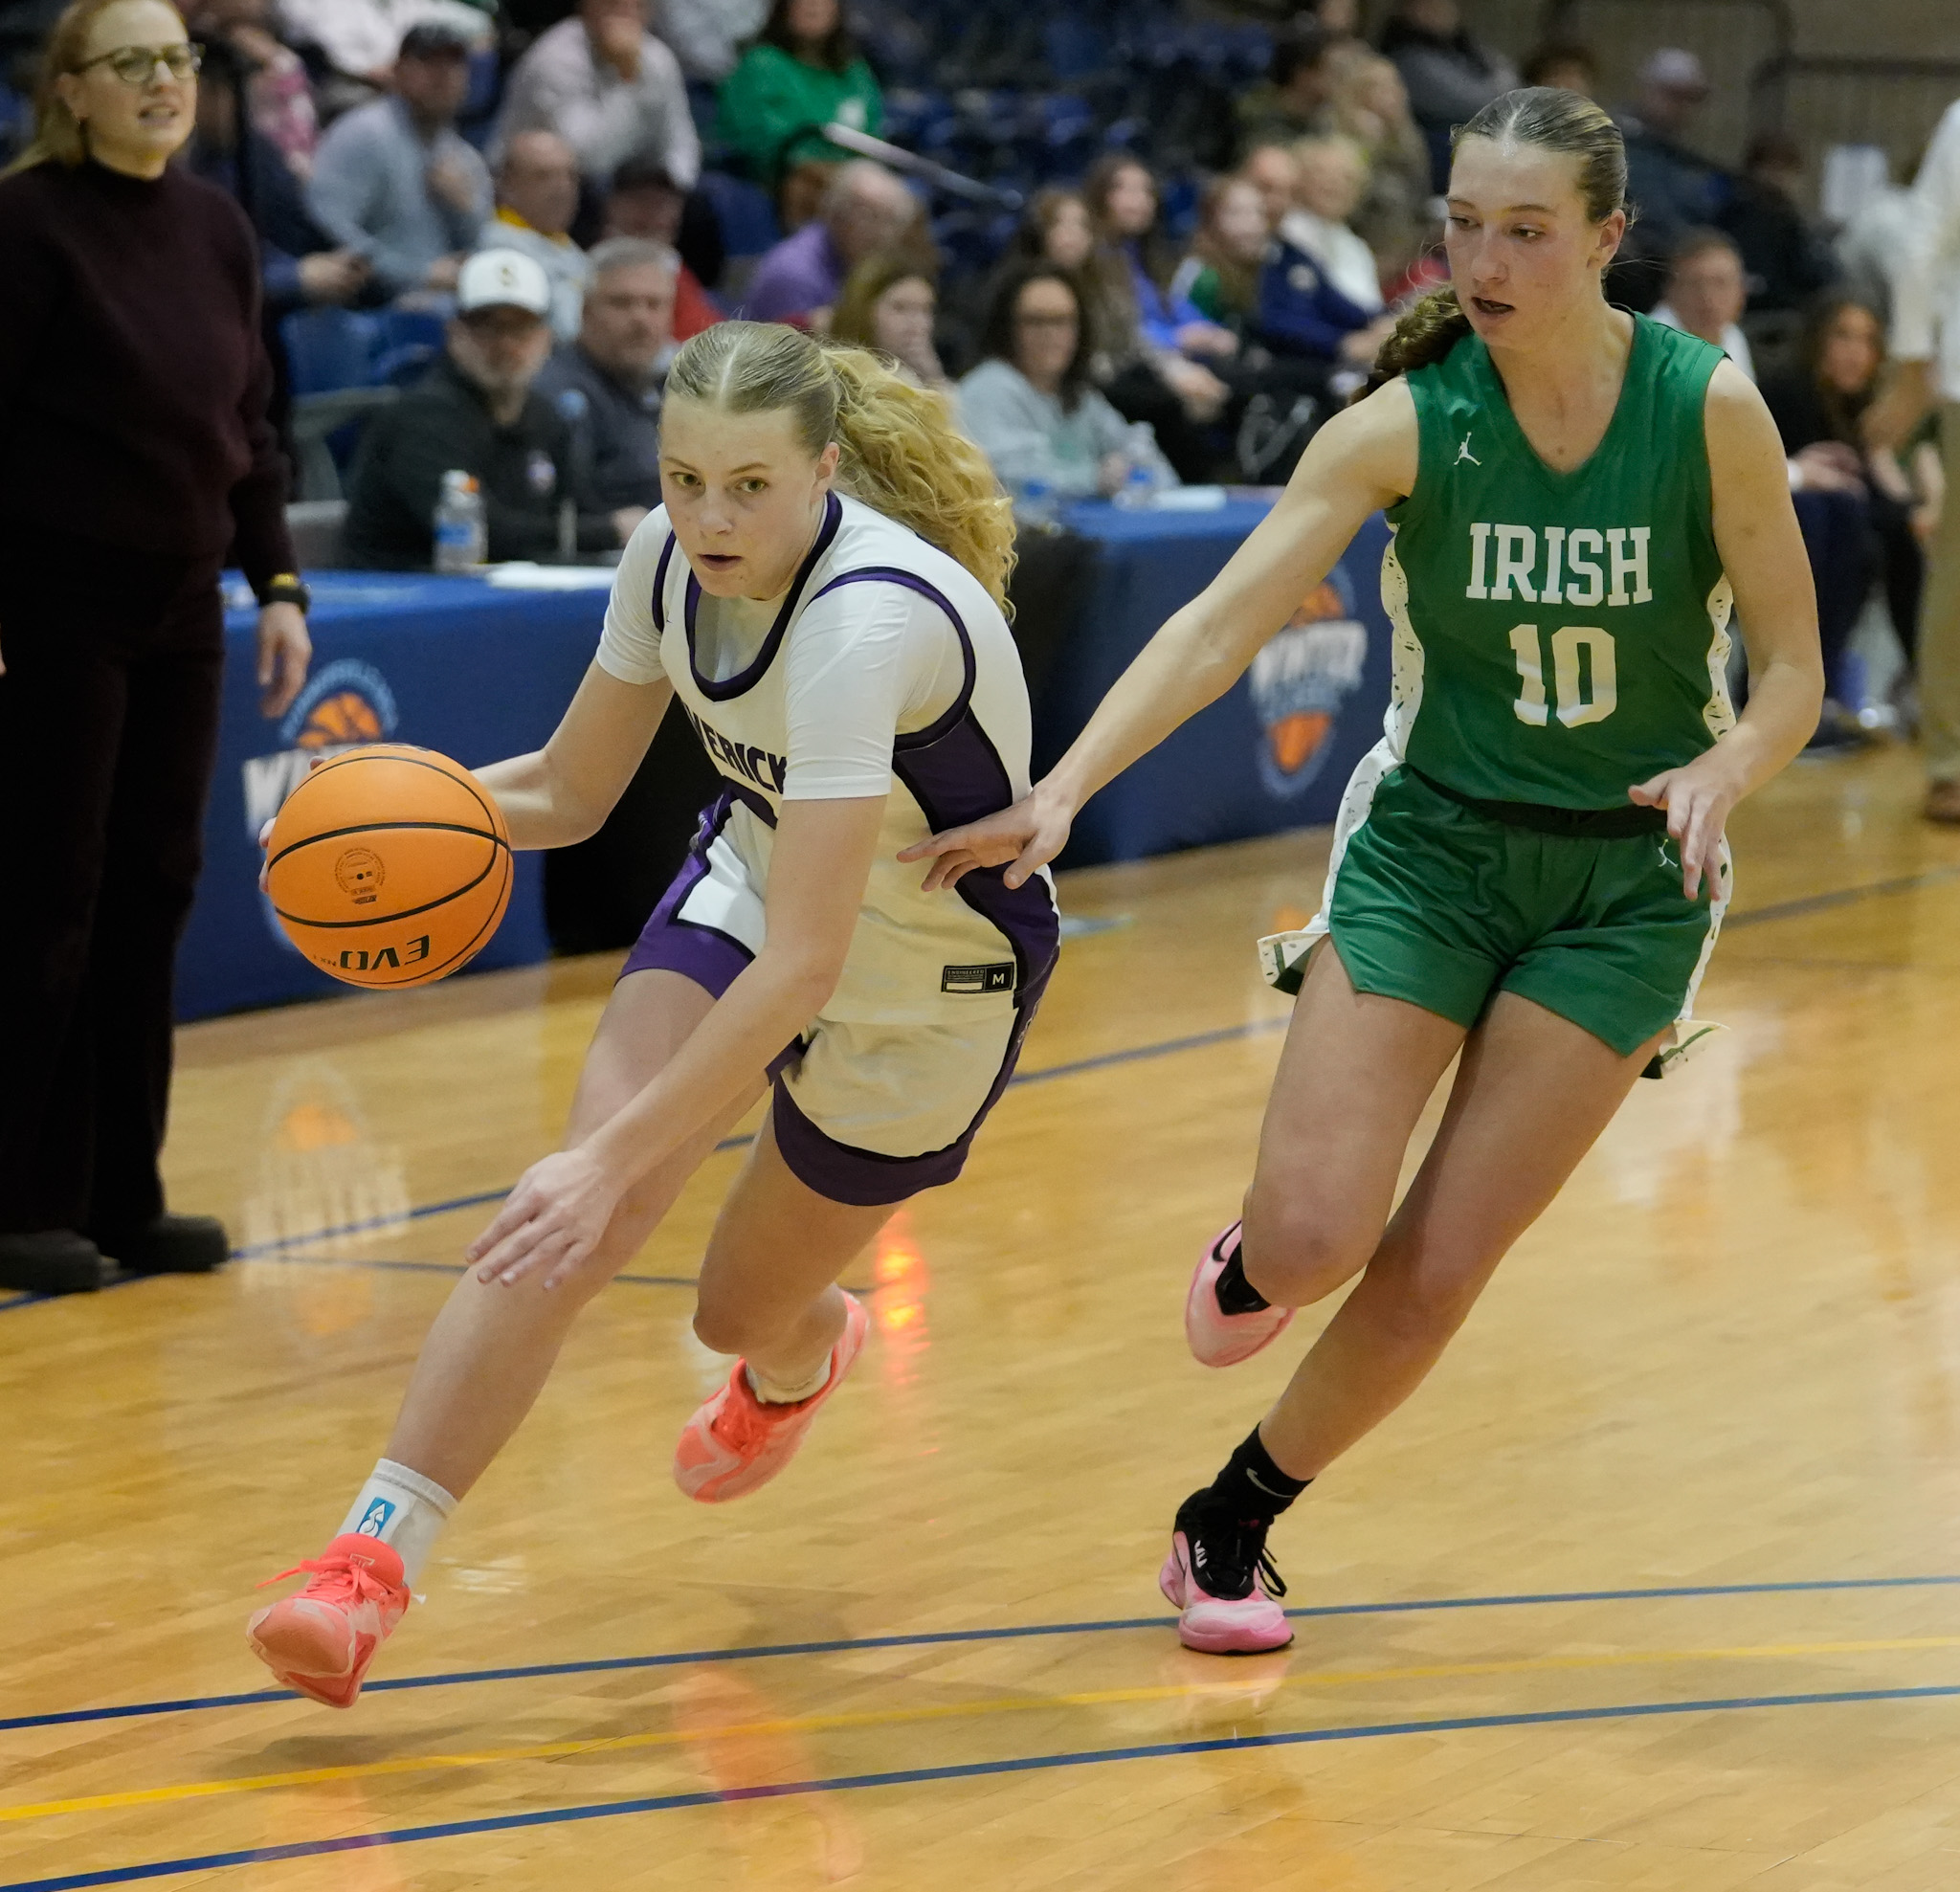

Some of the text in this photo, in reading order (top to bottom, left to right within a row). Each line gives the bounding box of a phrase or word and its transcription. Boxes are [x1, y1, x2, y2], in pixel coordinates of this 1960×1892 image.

[1465, 522, 1653, 607] IRISH
[1508, 624, 1617, 728] 10
[340, 934, 430, 971] EVO
[992, 972, 1005, 985] M
